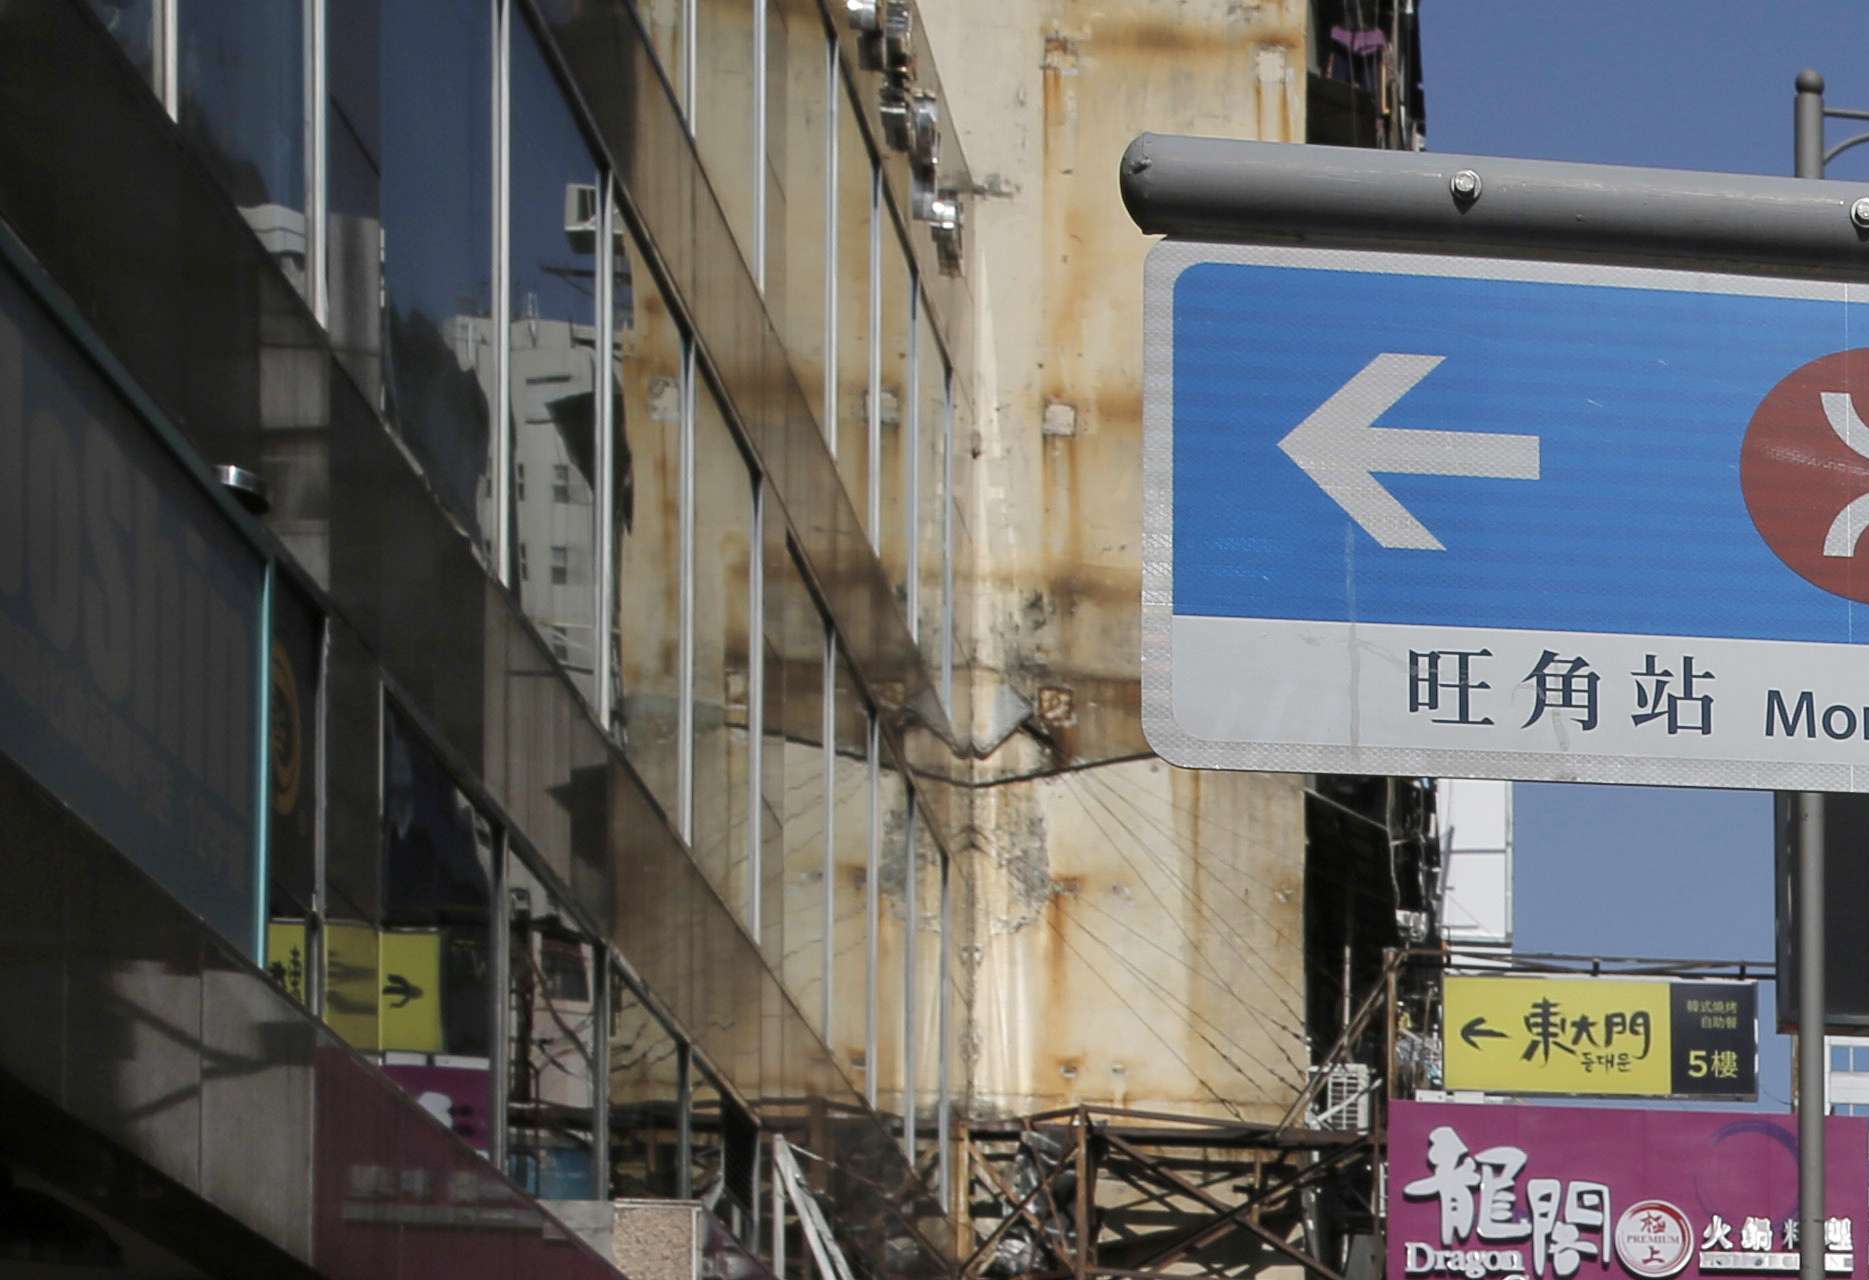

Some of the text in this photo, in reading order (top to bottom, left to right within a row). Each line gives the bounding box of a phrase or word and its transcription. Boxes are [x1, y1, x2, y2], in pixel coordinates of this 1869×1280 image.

[1405, 648, 1716, 738] 旺角站
[1520, 997, 1651, 1067] 東大門
[1688, 1050, 1738, 1078] 5樓
[1626, 1233, 1681, 1246] PREMIUM
[1404, 1241, 1526, 1279] Dragon
